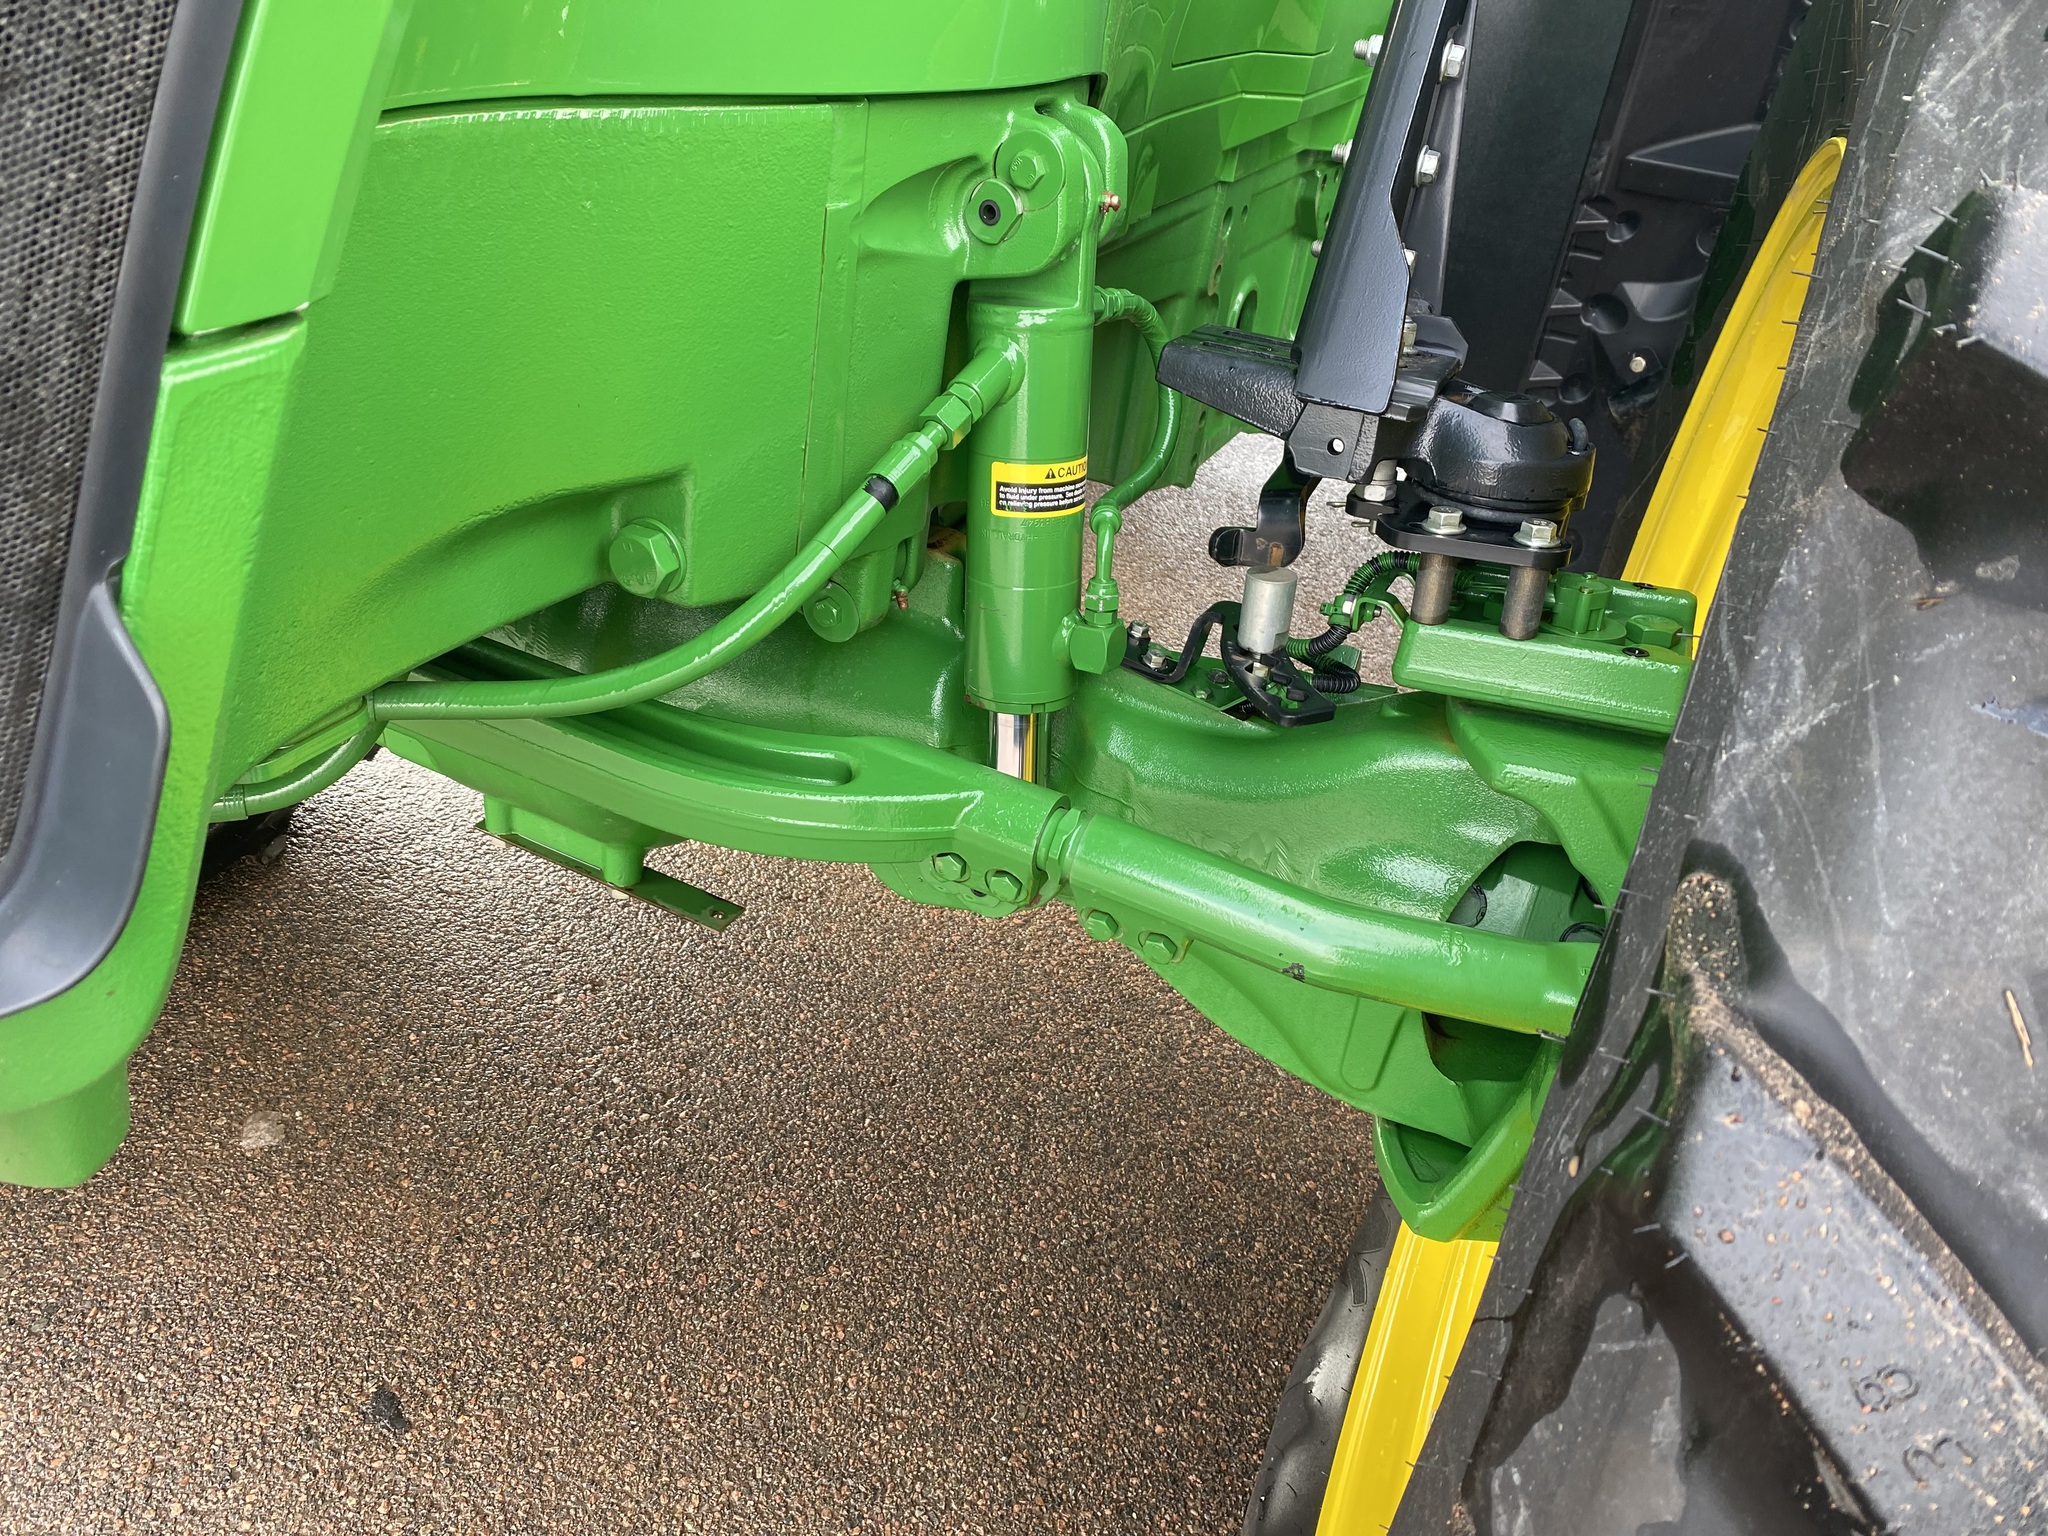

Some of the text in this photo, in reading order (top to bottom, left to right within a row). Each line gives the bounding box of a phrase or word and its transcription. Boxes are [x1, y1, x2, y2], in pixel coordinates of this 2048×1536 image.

[999, 485, 1018, 493] Avoid
[1054, 484, 1075, 492] machine
[1033, 500, 1058, 508] pressure
